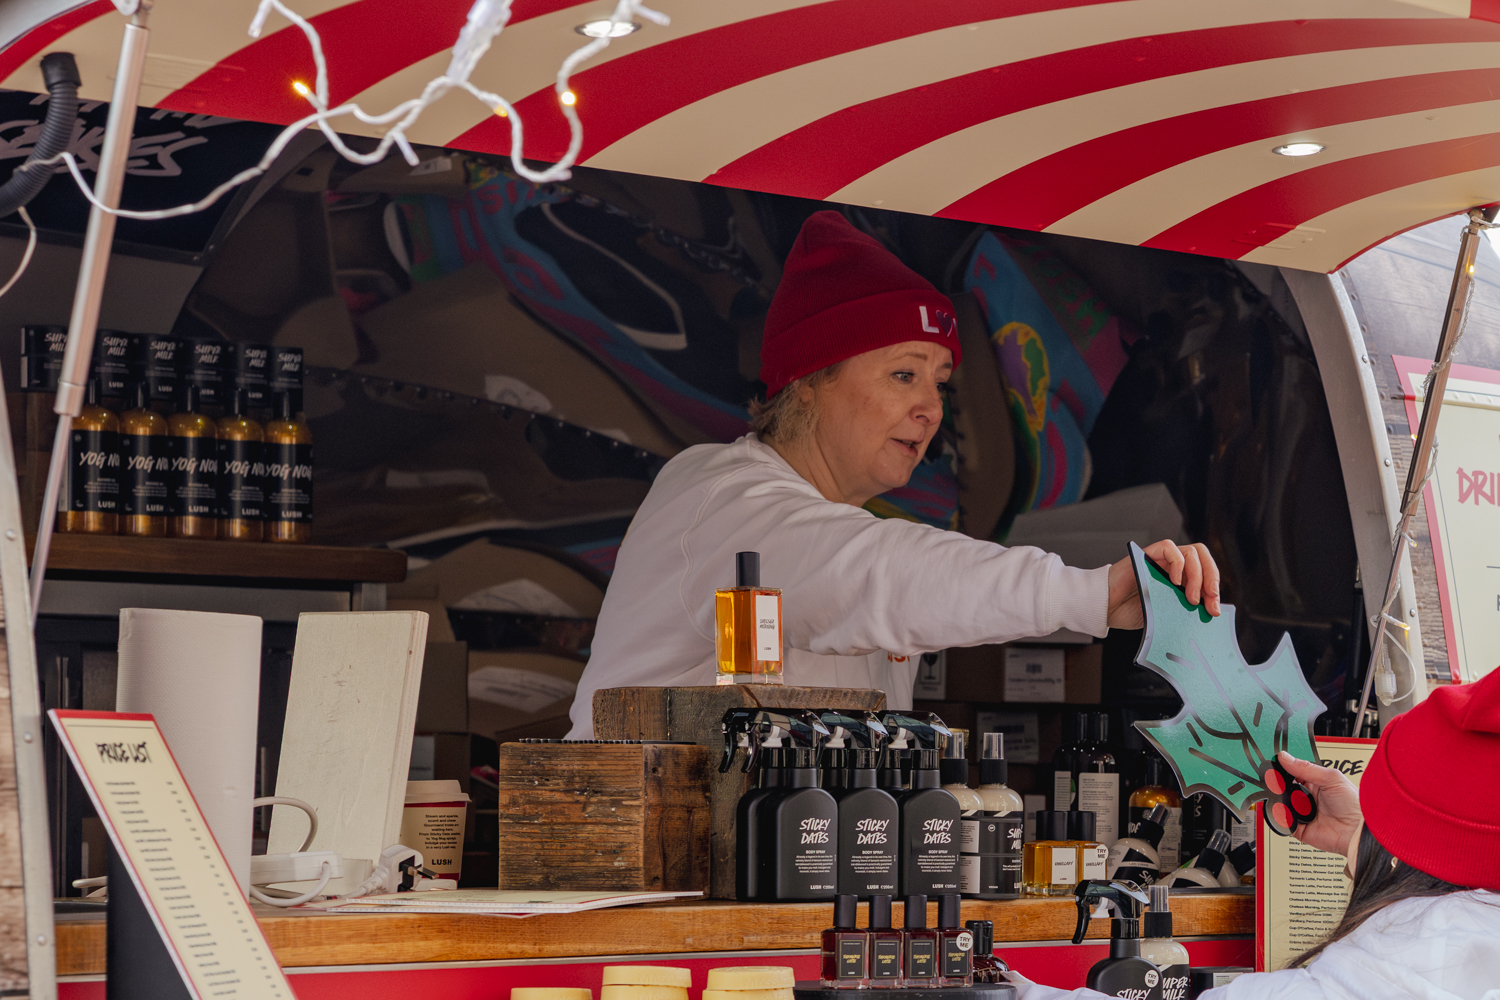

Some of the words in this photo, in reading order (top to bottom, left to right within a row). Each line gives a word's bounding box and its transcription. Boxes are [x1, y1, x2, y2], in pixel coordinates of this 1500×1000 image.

[79, 452, 107, 470] YOG
[108, 452, 120, 468] NO
[127, 455, 155, 473] YOG
[156, 457, 169, 471] NO
[170, 457, 198, 475] YOG
[224, 460, 251, 478] YOG
[264, 463, 292, 480] YOG
[95, 742, 130, 764] PRICE
[799, 818, 831, 831] STICKY
[855, 818, 890, 831] STICKY
[922, 818, 954, 831] STICKY
[801, 831, 829, 844] DATES
[857, 832, 888, 844] DATES
[924, 832, 952, 844] DATES
[1163, 976, 1188, 989] UPER
[1116, 988, 1151, 1000] STICKY
